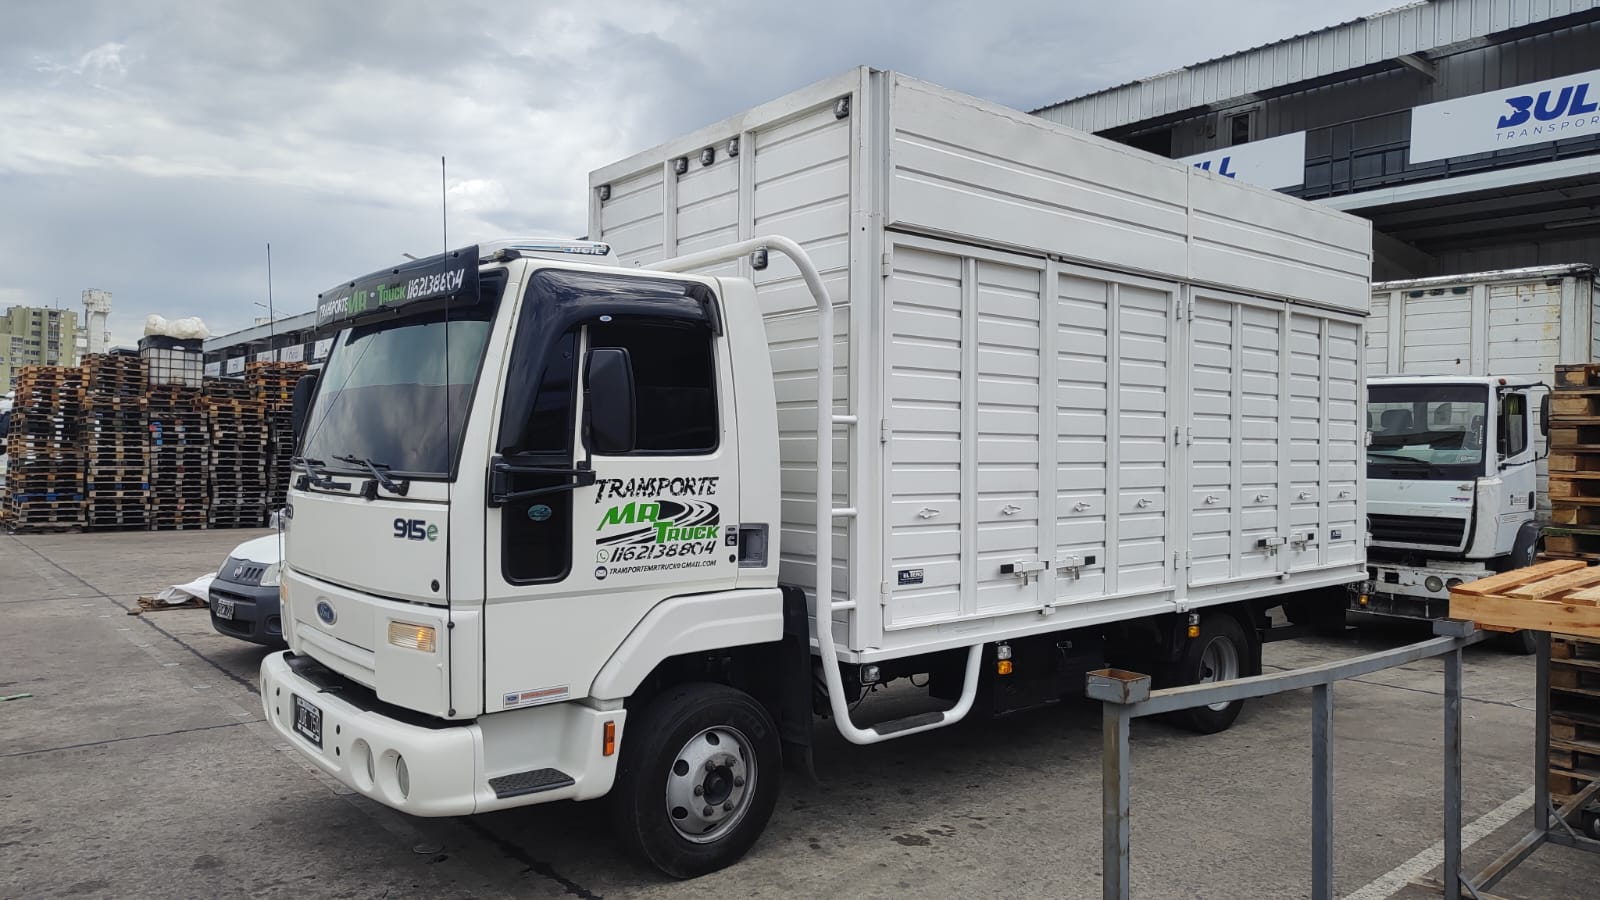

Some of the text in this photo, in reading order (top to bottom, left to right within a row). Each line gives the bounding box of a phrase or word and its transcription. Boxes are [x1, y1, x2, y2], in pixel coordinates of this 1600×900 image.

[1496, 82, 1600, 129] BUL
[595, 476, 719, 504] TRANSPORTE
[596, 501, 660, 531] MR
[393, 518, 439, 541] 915e
[653, 521, 720, 543] TRUCK
[610, 540, 717, 563] 1162138804
